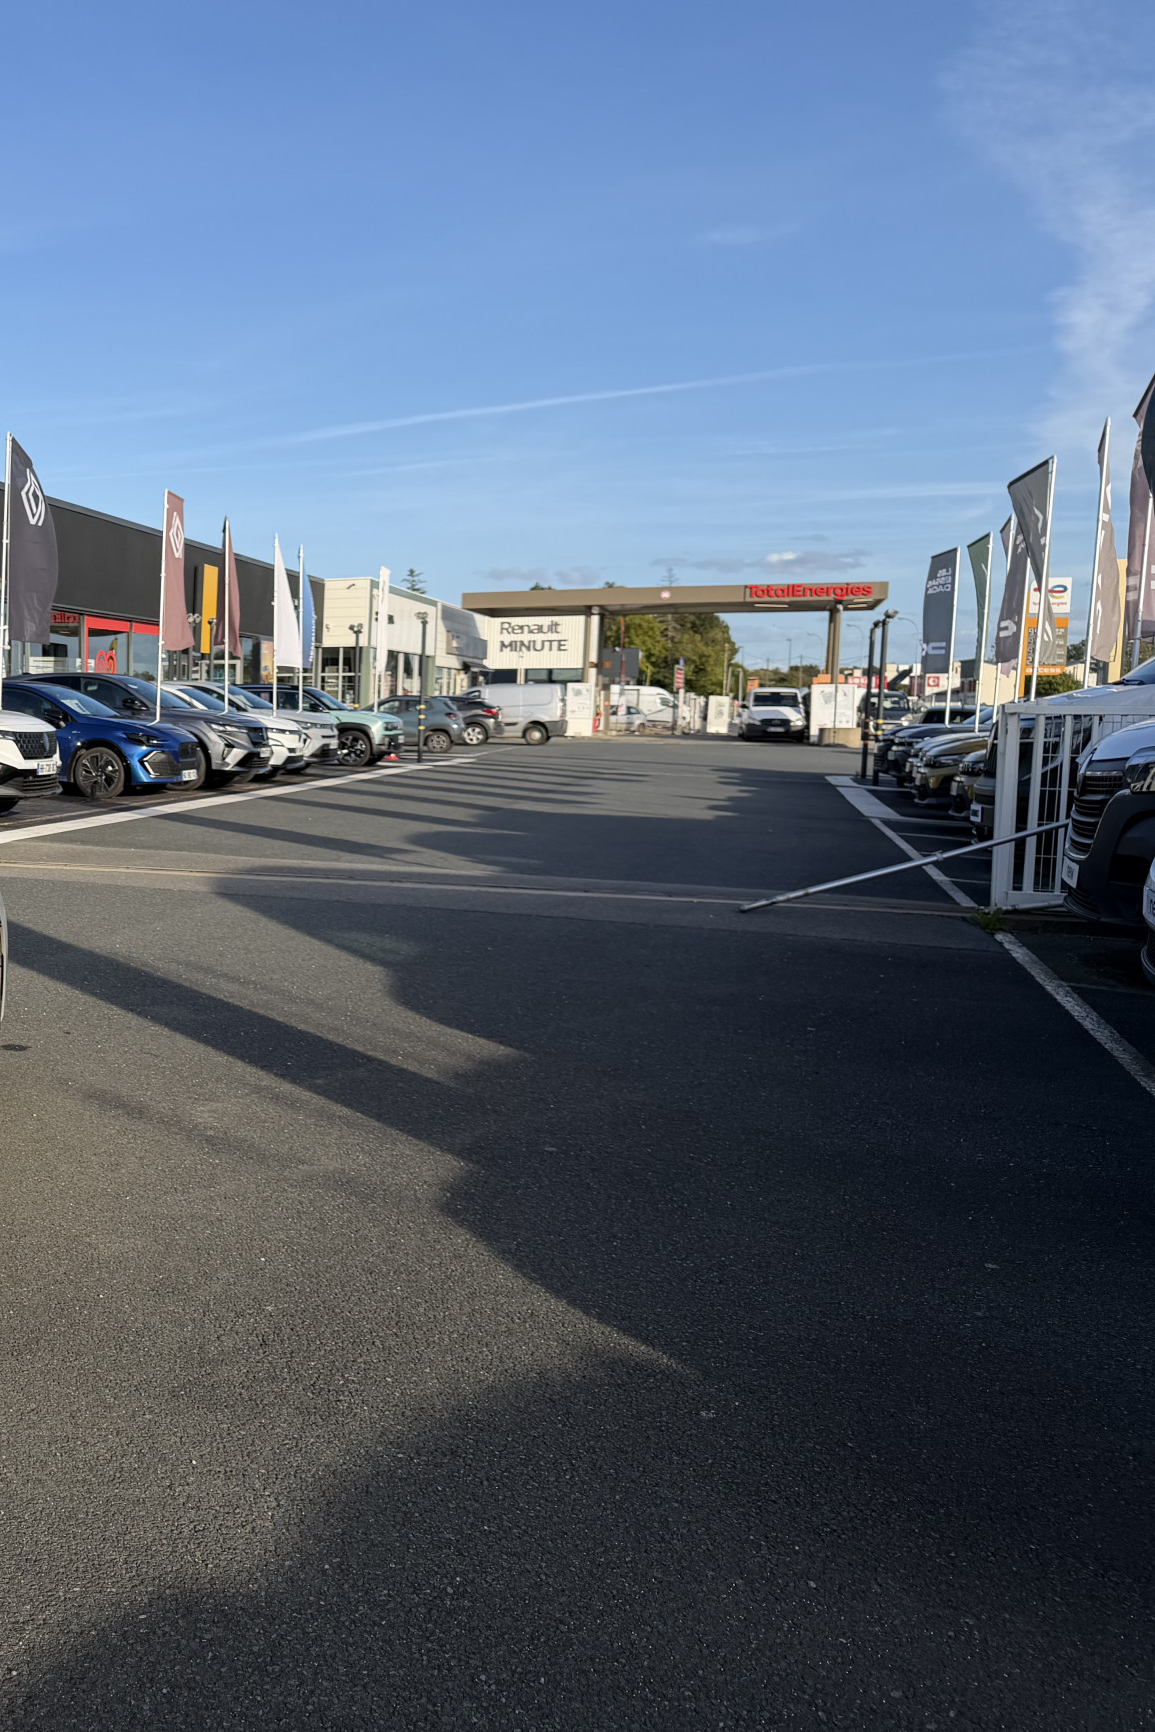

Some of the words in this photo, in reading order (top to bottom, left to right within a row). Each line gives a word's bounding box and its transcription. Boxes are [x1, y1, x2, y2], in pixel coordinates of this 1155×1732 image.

[747, 582, 873, 600] TotalEnergies
[500, 620, 561, 635] Renault
[499, 639, 569, 652] MINUTE
